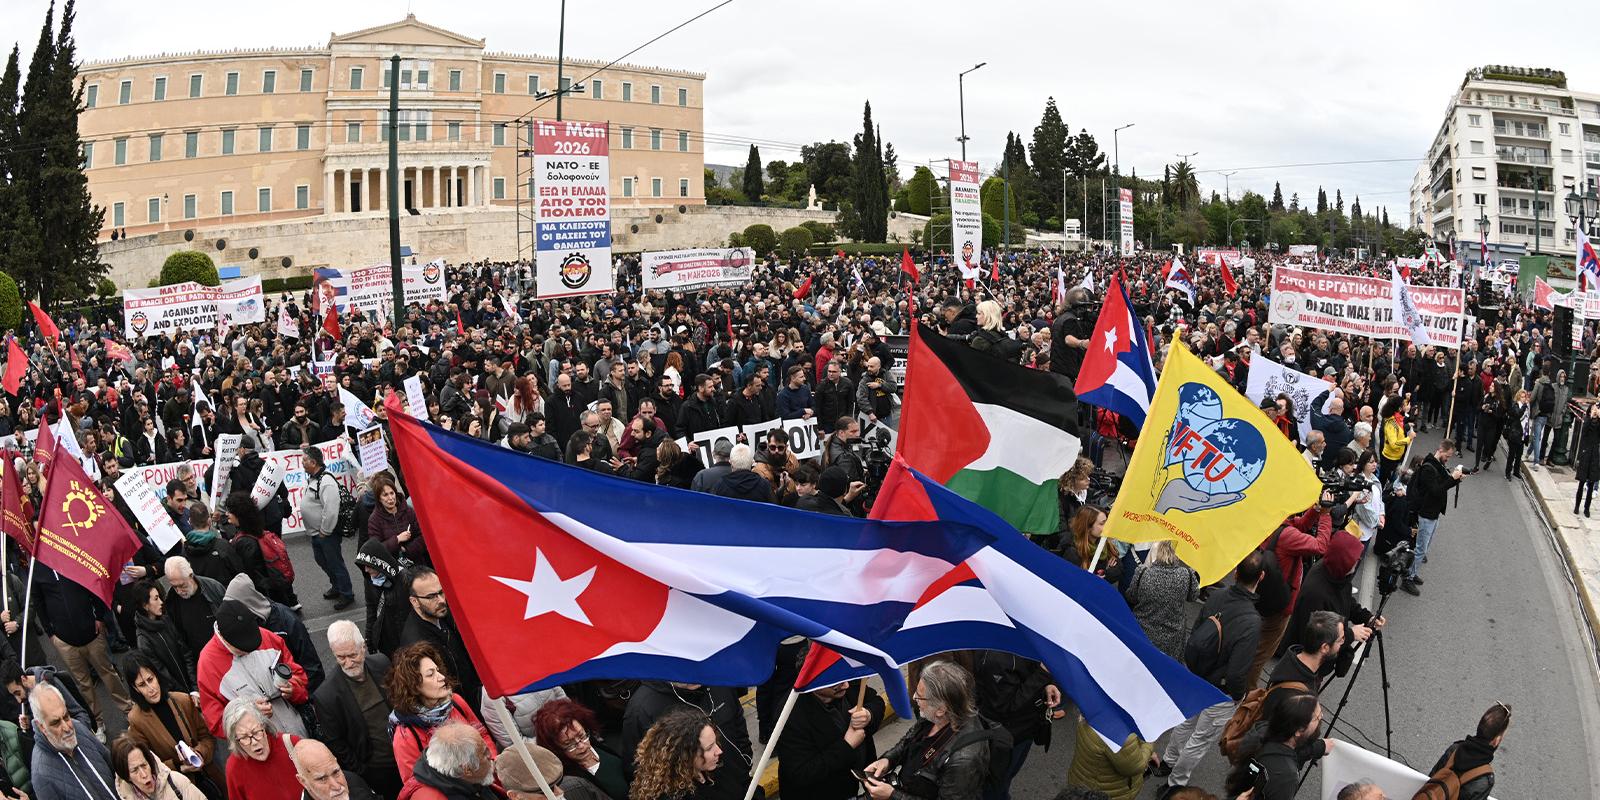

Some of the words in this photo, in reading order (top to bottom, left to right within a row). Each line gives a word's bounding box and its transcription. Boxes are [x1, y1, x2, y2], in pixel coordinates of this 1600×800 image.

[566, 121, 605, 138] Μάη
[554, 141, 590, 154] 2026
[546, 161, 578, 170] ΝΑΤΟ
[589, 162, 600, 170] ΕΕ
[547, 170, 600, 181] δολοφονούν
[540, 186, 559, 196] ΕΞΩ
[561, 186, 568, 196] Η
[571, 186, 606, 197] ΕΛΛΑΔΑ
[540, 198, 574, 207] ΑΠΟ
[576, 197, 606, 206] ΤΟΝ
[540, 208, 607, 217] ΠΟΛΕΜΟ
[541, 223, 557, 231] ΝΑ
[559, 221, 606, 230] ΚΛΕΙΣΟΥΝ
[541, 233, 553, 241] ΟΙ
[555, 231, 587, 240] ΒΑΣΕΙΣ
[589, 230, 607, 239] ΤΟΥ
[553, 240, 597, 250] ΘΑΝΑΤΟΥ
[352, 271, 366, 279] 100
[368, 266, 392, 275] ΧΡΟΝΙ
[701, 269, 720, 278] 2026
[160, 286, 178, 295] MAY
[181, 284, 197, 293] DAY
[1279, 275, 1306, 288] ΖΗΤΩ
[1309, 281, 1315, 290] Η
[1319, 280, 1377, 297] ΕΡΓΑΤΙΚΗ
[1380, 287, 1459, 307] ΠΟΜΑΓΙΑ
[140, 298, 162, 306] MARCH
[176, 295, 187, 303] THE
[189, 293, 205, 301] PATH
[217, 287, 257, 299] OVERTHROW
[162, 305, 198, 318] AGAINST
[1306, 299, 1317, 312] ΟΙ
[1319, 301, 1344, 318] ΖΩΕΣ
[1347, 304, 1370, 320] ΜΑΣ
[1433, 316, 1458, 331] ΤΟΥΣ
[153, 320, 171, 330] AND
[173, 313, 232, 328] EXPLOITATN
